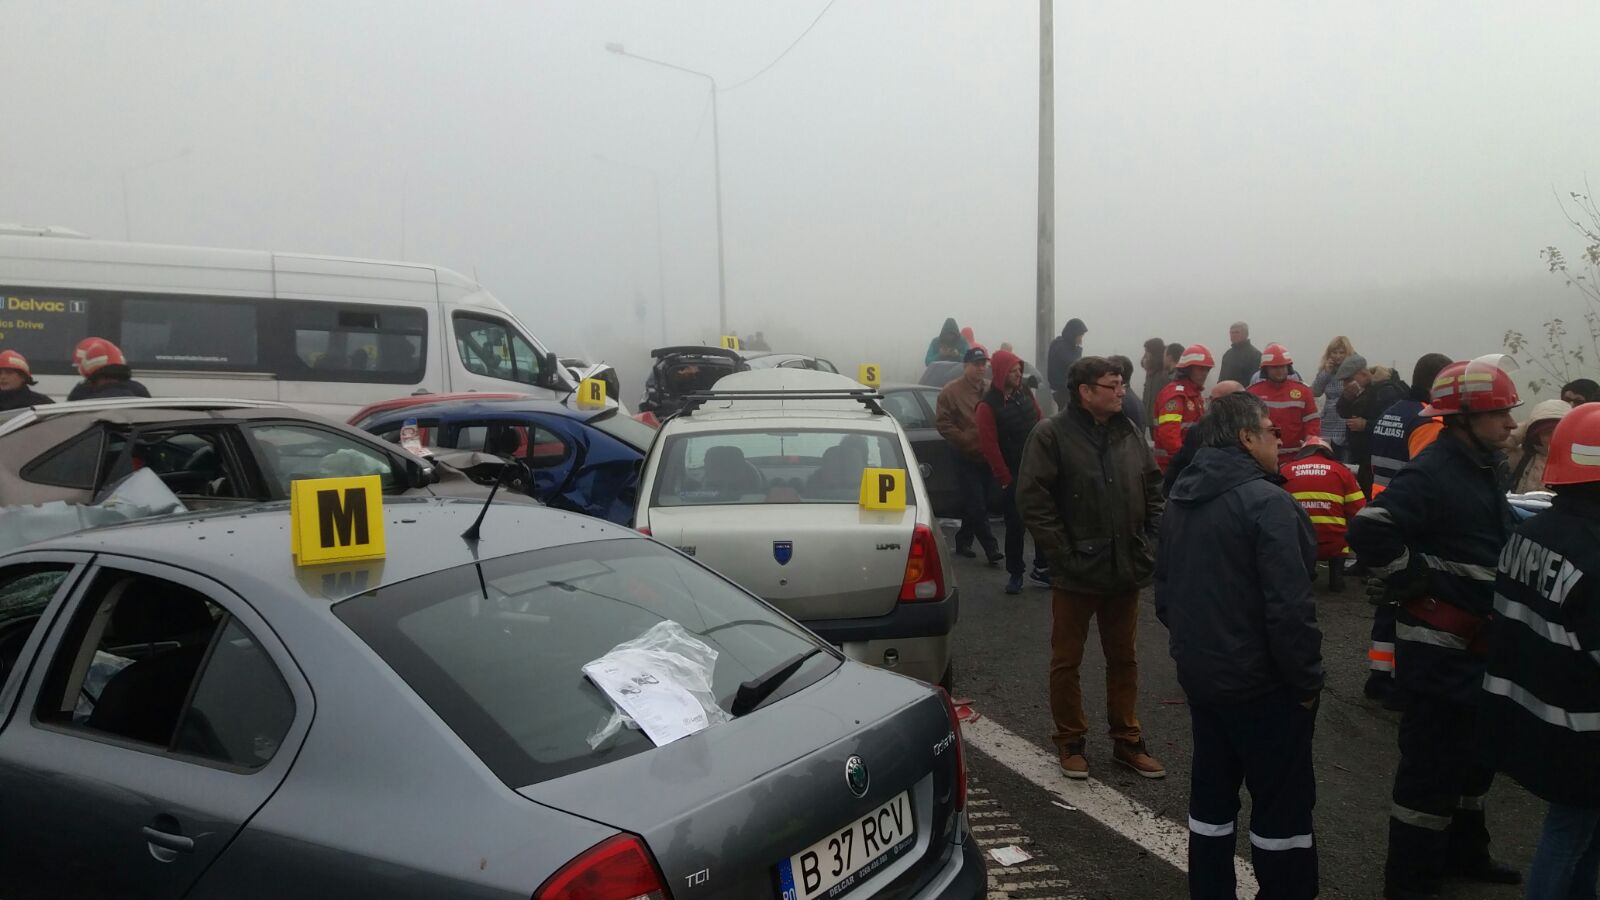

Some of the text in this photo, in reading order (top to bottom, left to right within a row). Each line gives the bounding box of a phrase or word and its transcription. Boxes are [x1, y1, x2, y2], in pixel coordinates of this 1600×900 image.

[8, 297, 64, 311] Delvac
[16, 320, 44, 329] Drive
[866, 366, 876, 381] S
[590, 382, 601, 400] R
[879, 473, 895, 503] P
[317, 487, 370, 548] M
[800, 797, 903, 896] B 37 RCV
[685, 868, 710, 888] TDI
[828, 875, 855, 897] DELCAR
